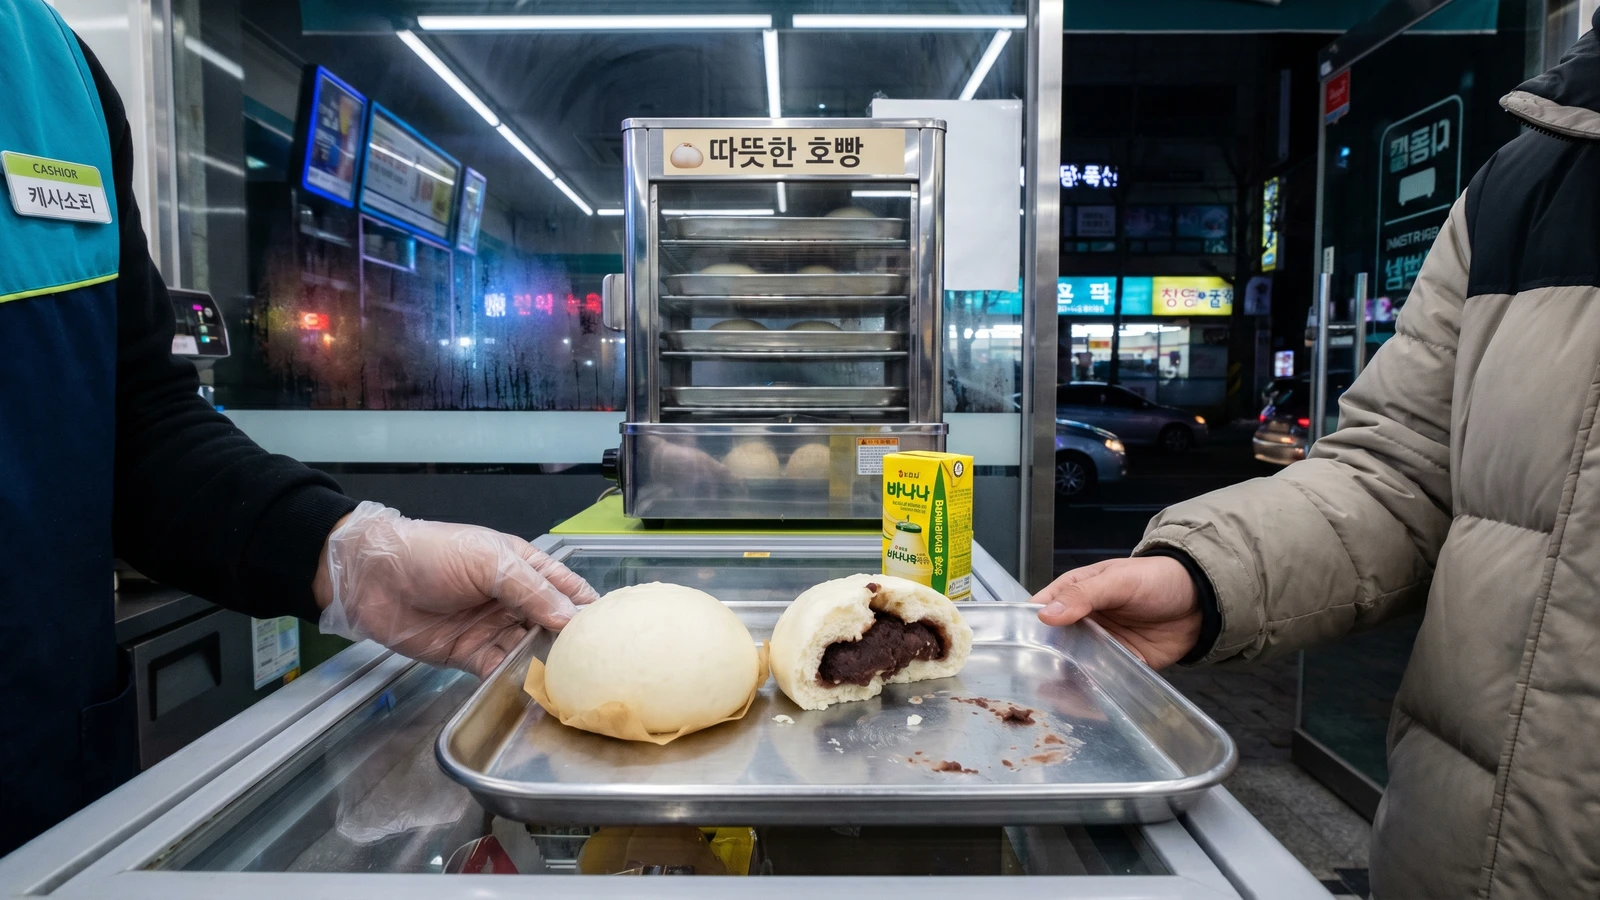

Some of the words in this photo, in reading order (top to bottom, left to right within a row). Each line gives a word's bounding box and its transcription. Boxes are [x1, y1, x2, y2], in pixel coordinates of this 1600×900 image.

[709, 136, 797, 168] 따뜻한
[805, 136, 864, 168] 호빵
[32, 163, 79, 179] CASHIOR
[886, 481, 931, 502] 바나나
